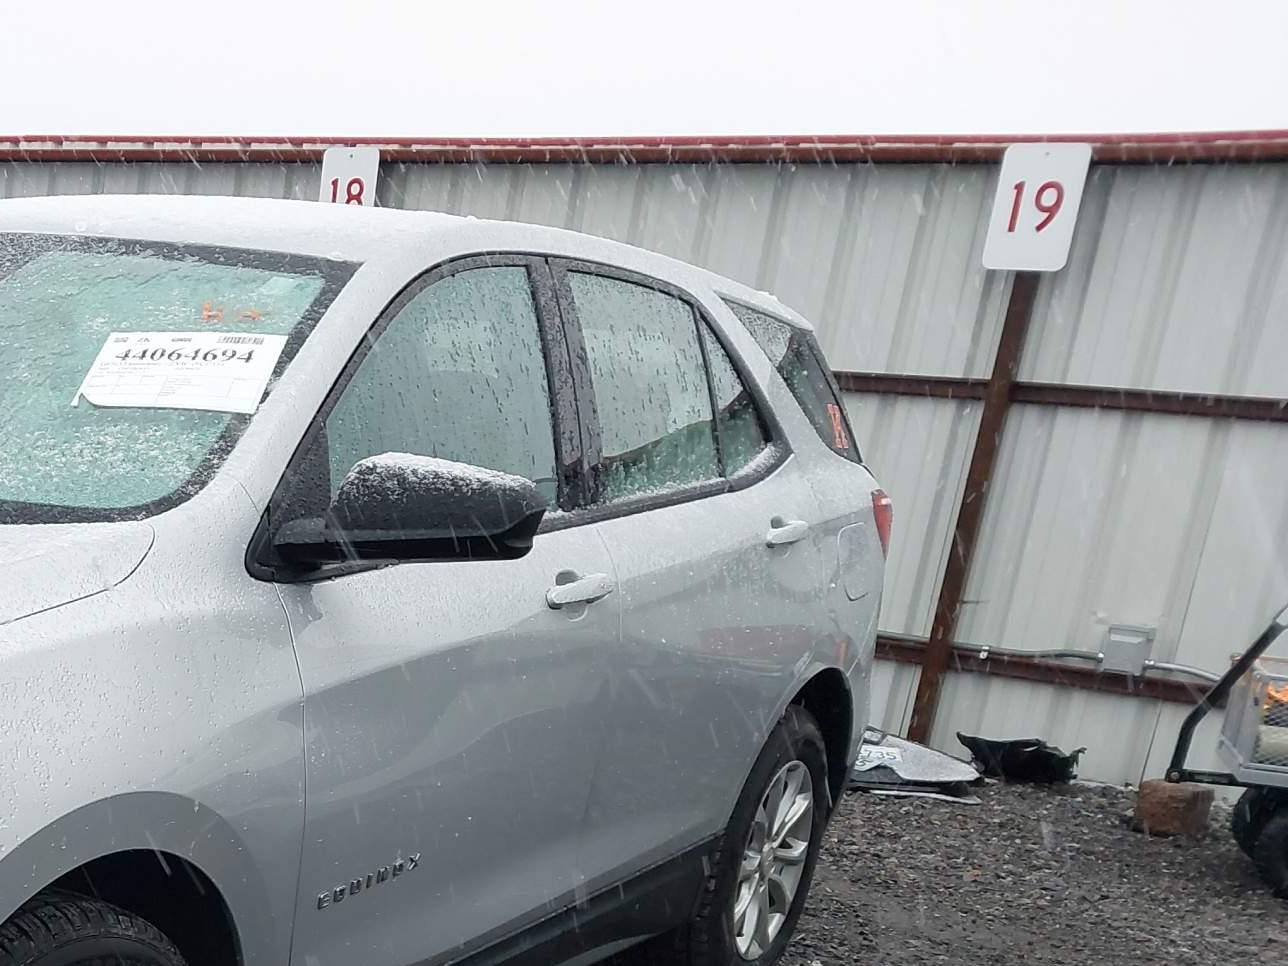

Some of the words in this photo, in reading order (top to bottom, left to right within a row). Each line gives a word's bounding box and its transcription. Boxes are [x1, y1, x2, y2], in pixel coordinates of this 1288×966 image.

[331, 178, 364, 206] 18
[1008, 181, 1065, 233] 19
[114, 347, 255, 363] 44064694
